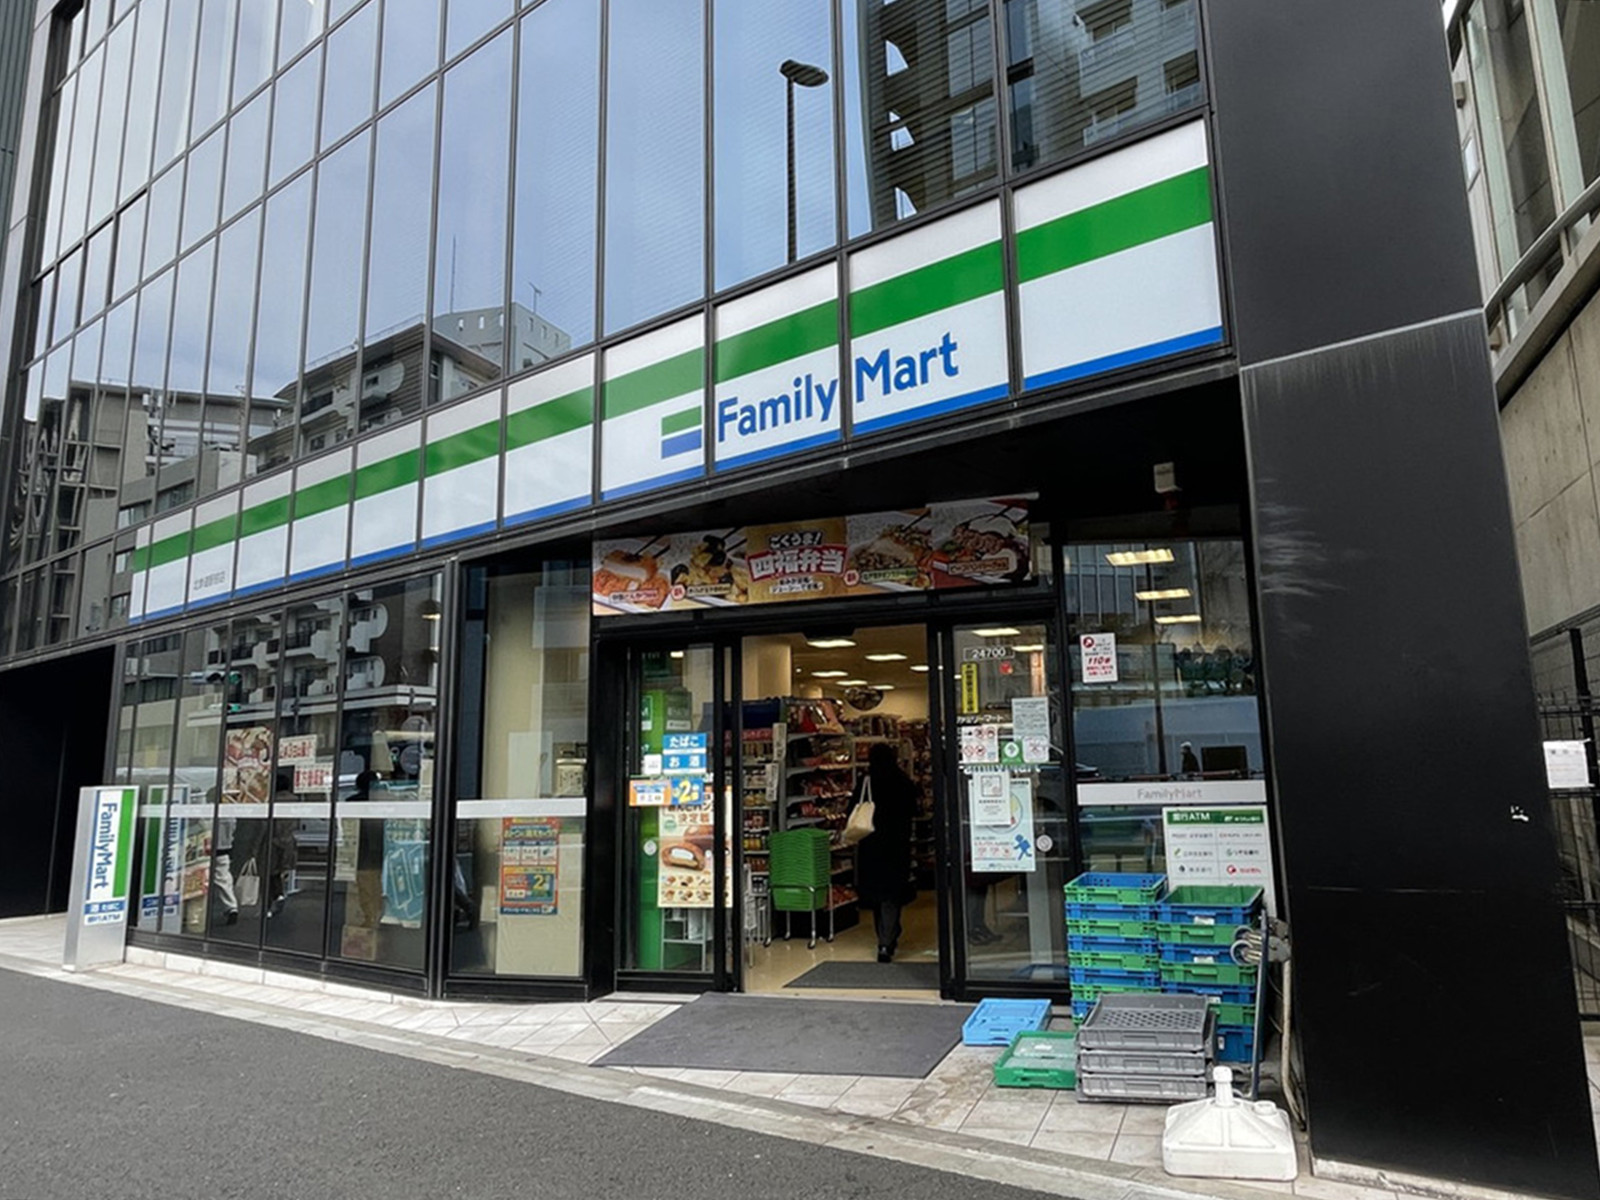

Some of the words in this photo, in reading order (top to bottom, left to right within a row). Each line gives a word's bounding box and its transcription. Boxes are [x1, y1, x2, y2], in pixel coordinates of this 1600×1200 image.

[718, 373, 839, 443] Family
[855, 332, 960, 404] Mart
[749, 547, 844, 580] 四福弁当
[971, 647, 1006, 659] 24700
[669, 736, 700, 748] たばこ
[1137, 787, 1202, 801] FamilyMart
[94, 803, 118, 889] FamilyMart
